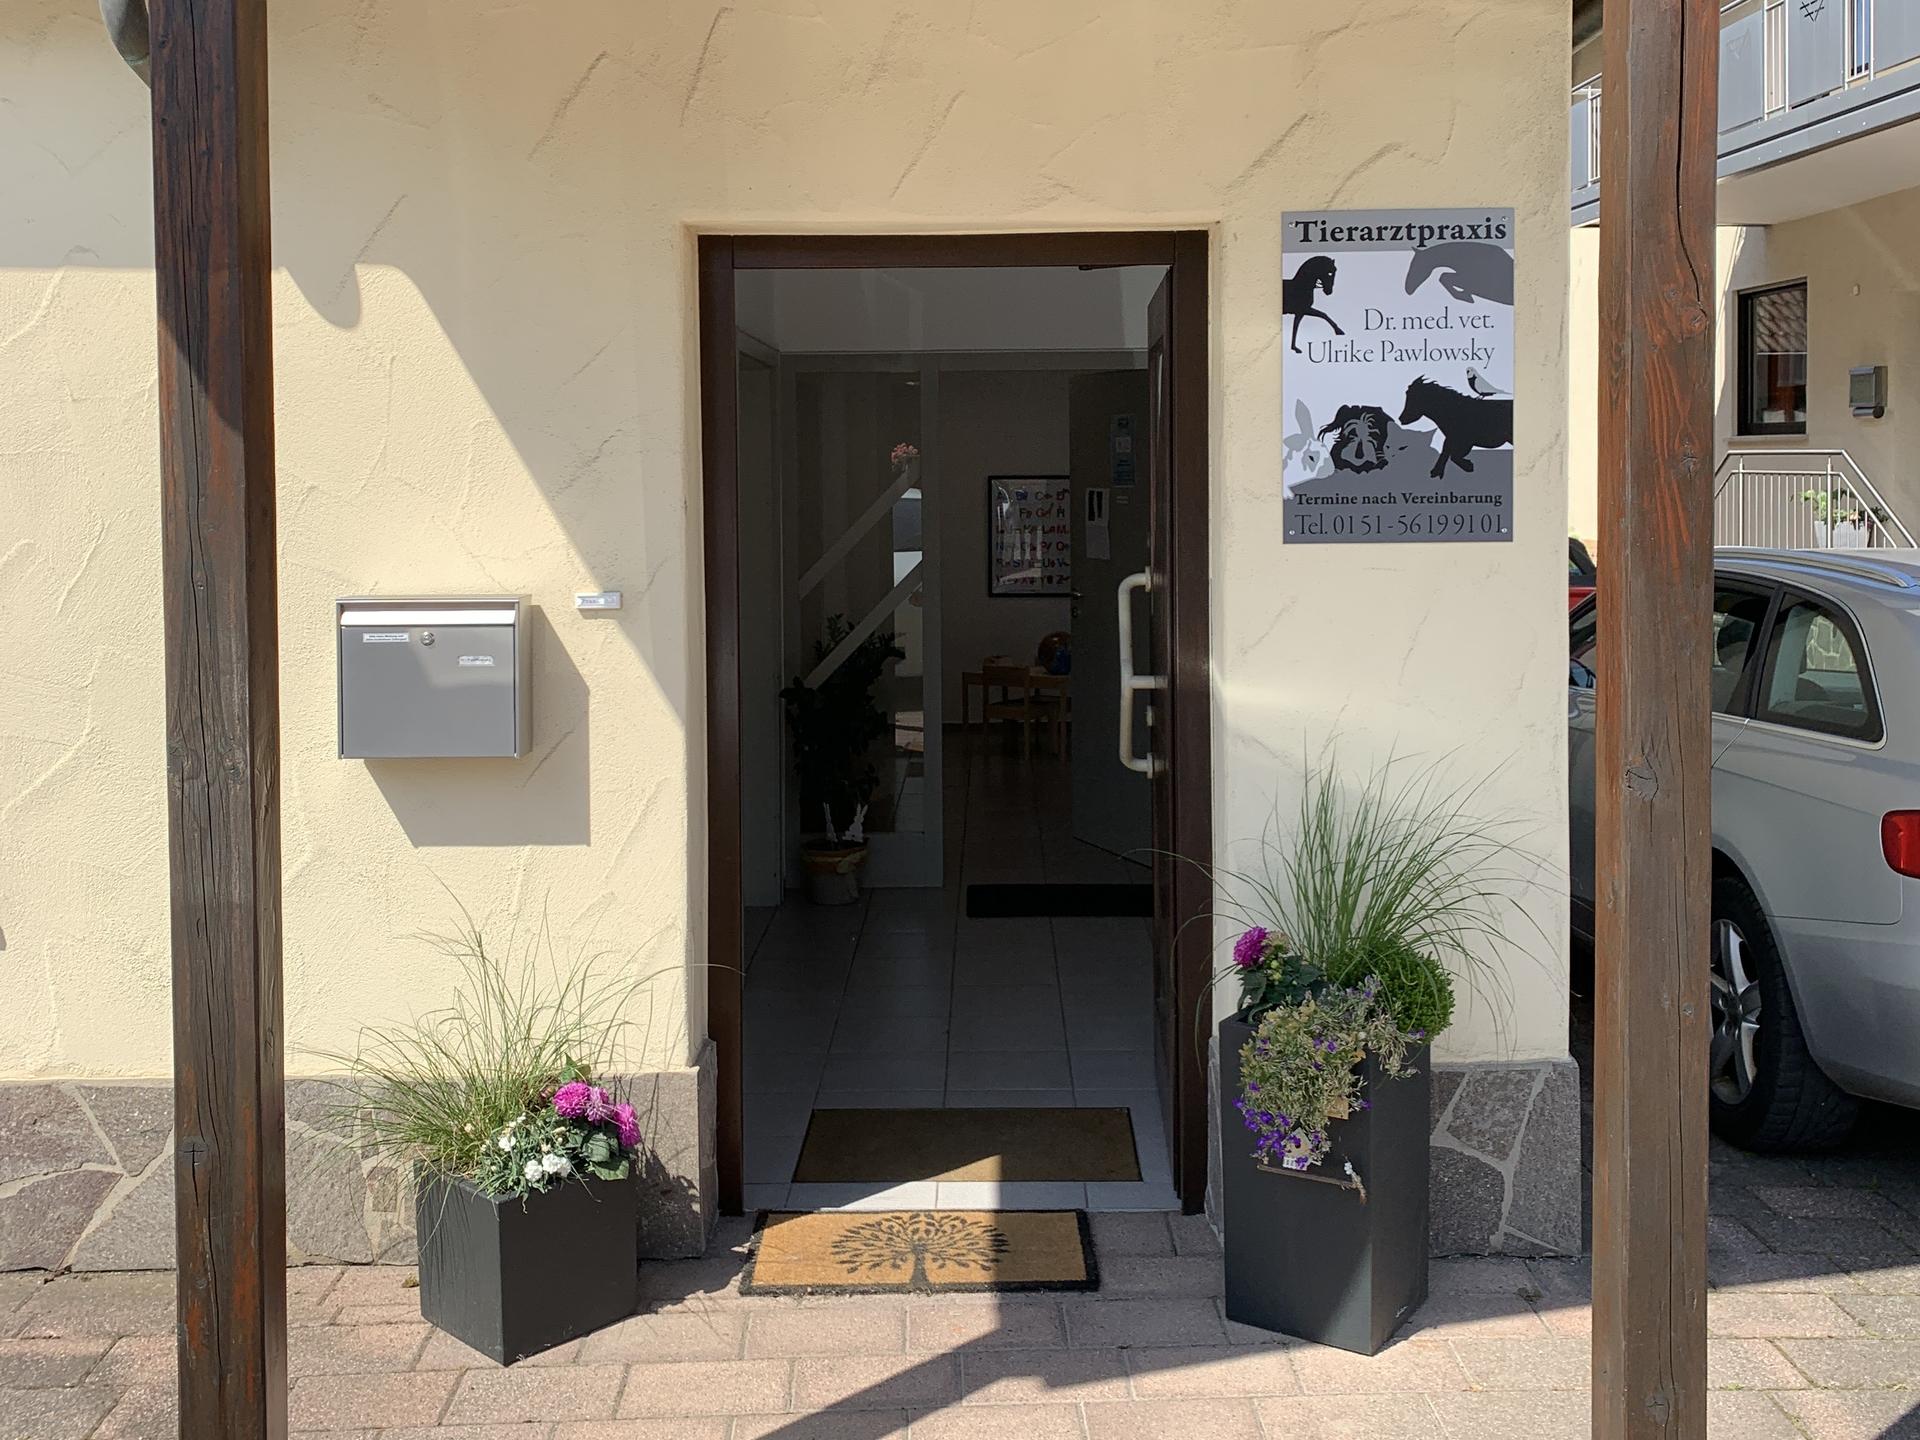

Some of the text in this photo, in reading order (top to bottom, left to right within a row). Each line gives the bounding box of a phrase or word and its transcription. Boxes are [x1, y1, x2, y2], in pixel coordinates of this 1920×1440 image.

[1294, 217, 1507, 248] Tierarztpraxis
[1364, 305, 1495, 331] Dr. med. vet.
[1307, 338, 1496, 370] Ulrike Pawlowsky
[1294, 491, 1503, 507] Termine nach Vereinbarung
[1294, 513, 1328, 535] Tel.
